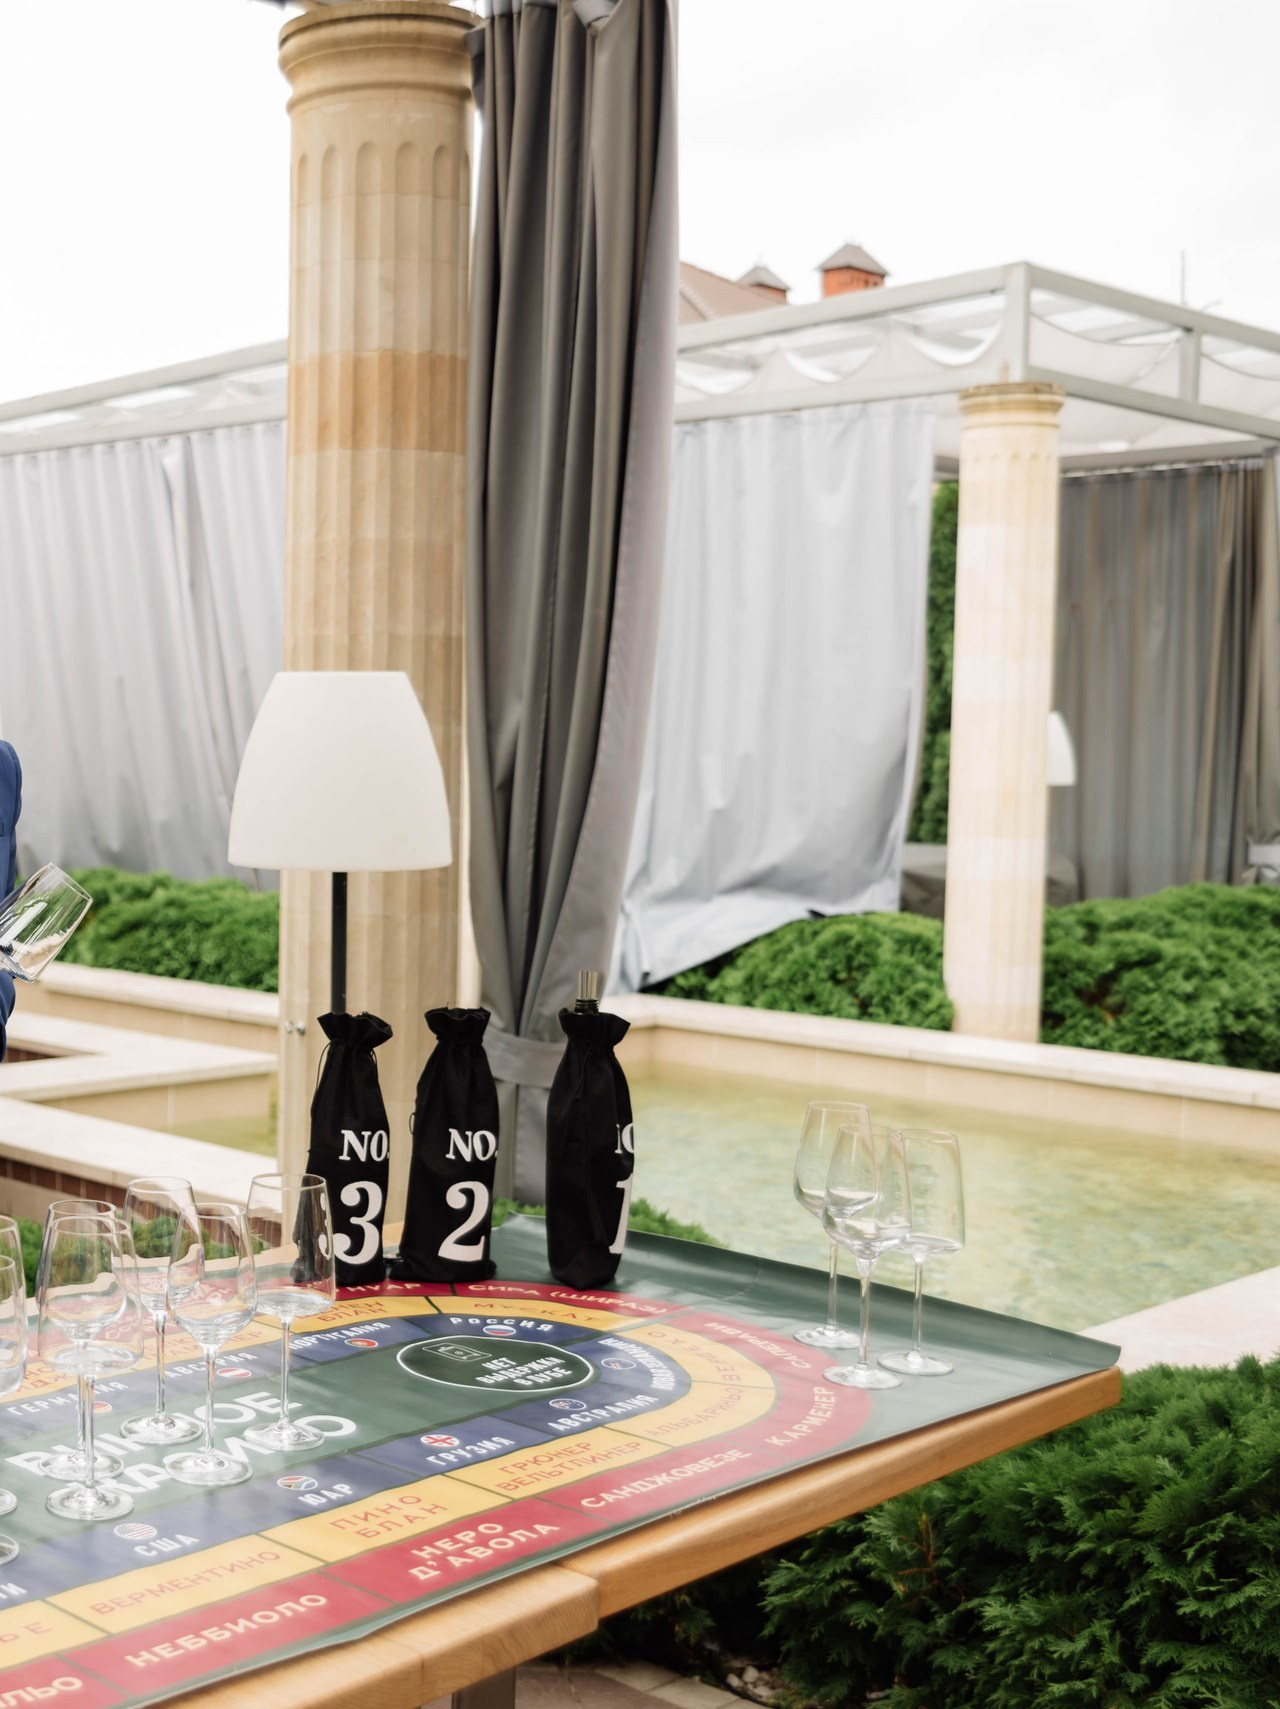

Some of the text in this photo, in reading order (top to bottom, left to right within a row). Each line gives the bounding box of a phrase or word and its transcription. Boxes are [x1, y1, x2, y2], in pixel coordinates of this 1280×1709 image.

[332, 1180, 383, 1265] 3
[437, 1180, 489, 1262] 2
[468, 1284, 541, 1296] СИРА
[449, 1317, 554, 1333] РОССИЯ
[474, 1302, 600, 1322] МУСКАТ
[288, 1321, 392, 1351] ПОРТУГАЛИЯ
[705, 1321, 813, 1370] САПЕРАВИ
[475, 1356, 566, 1385] ВЫДЕРЖКИ
[482, 1356, 518, 1372] НЕТ
[513, 1366, 573, 1387] В ДУБЕ
[6, 1381, 129, 1417] ГЕРМАИЯ
[547, 1394, 659, 1431] АВСТРАЛИЯ
[646, 1387, 744, 1438] АЛЬБАРИНЬО
[764, 1386, 837, 1447] КАРМЕНЕР
[425, 1435, 516, 1467] ГРУЗИЯ
[496, 1441, 643, 1492] ВЕЛЬТЛИНЕР
[498, 1441, 592, 1476] ГРЮНЕР
[297, 1482, 356, 1507] ЮАР
[580, 1448, 754, 1509] САНДЖОВЕЗЕ
[330, 1494, 423, 1531] ПИНО
[355, 1503, 449, 1540] БЛАН
[133, 1533, 200, 1557] США
[407, 1523, 561, 1581] Д'АВОЛА
[410, 1522, 504, 1560] НЕРО
[89, 1551, 282, 1616] ВЕРМЕНТИНО
[123, 1594, 329, 1668] НЕББИОЛО
